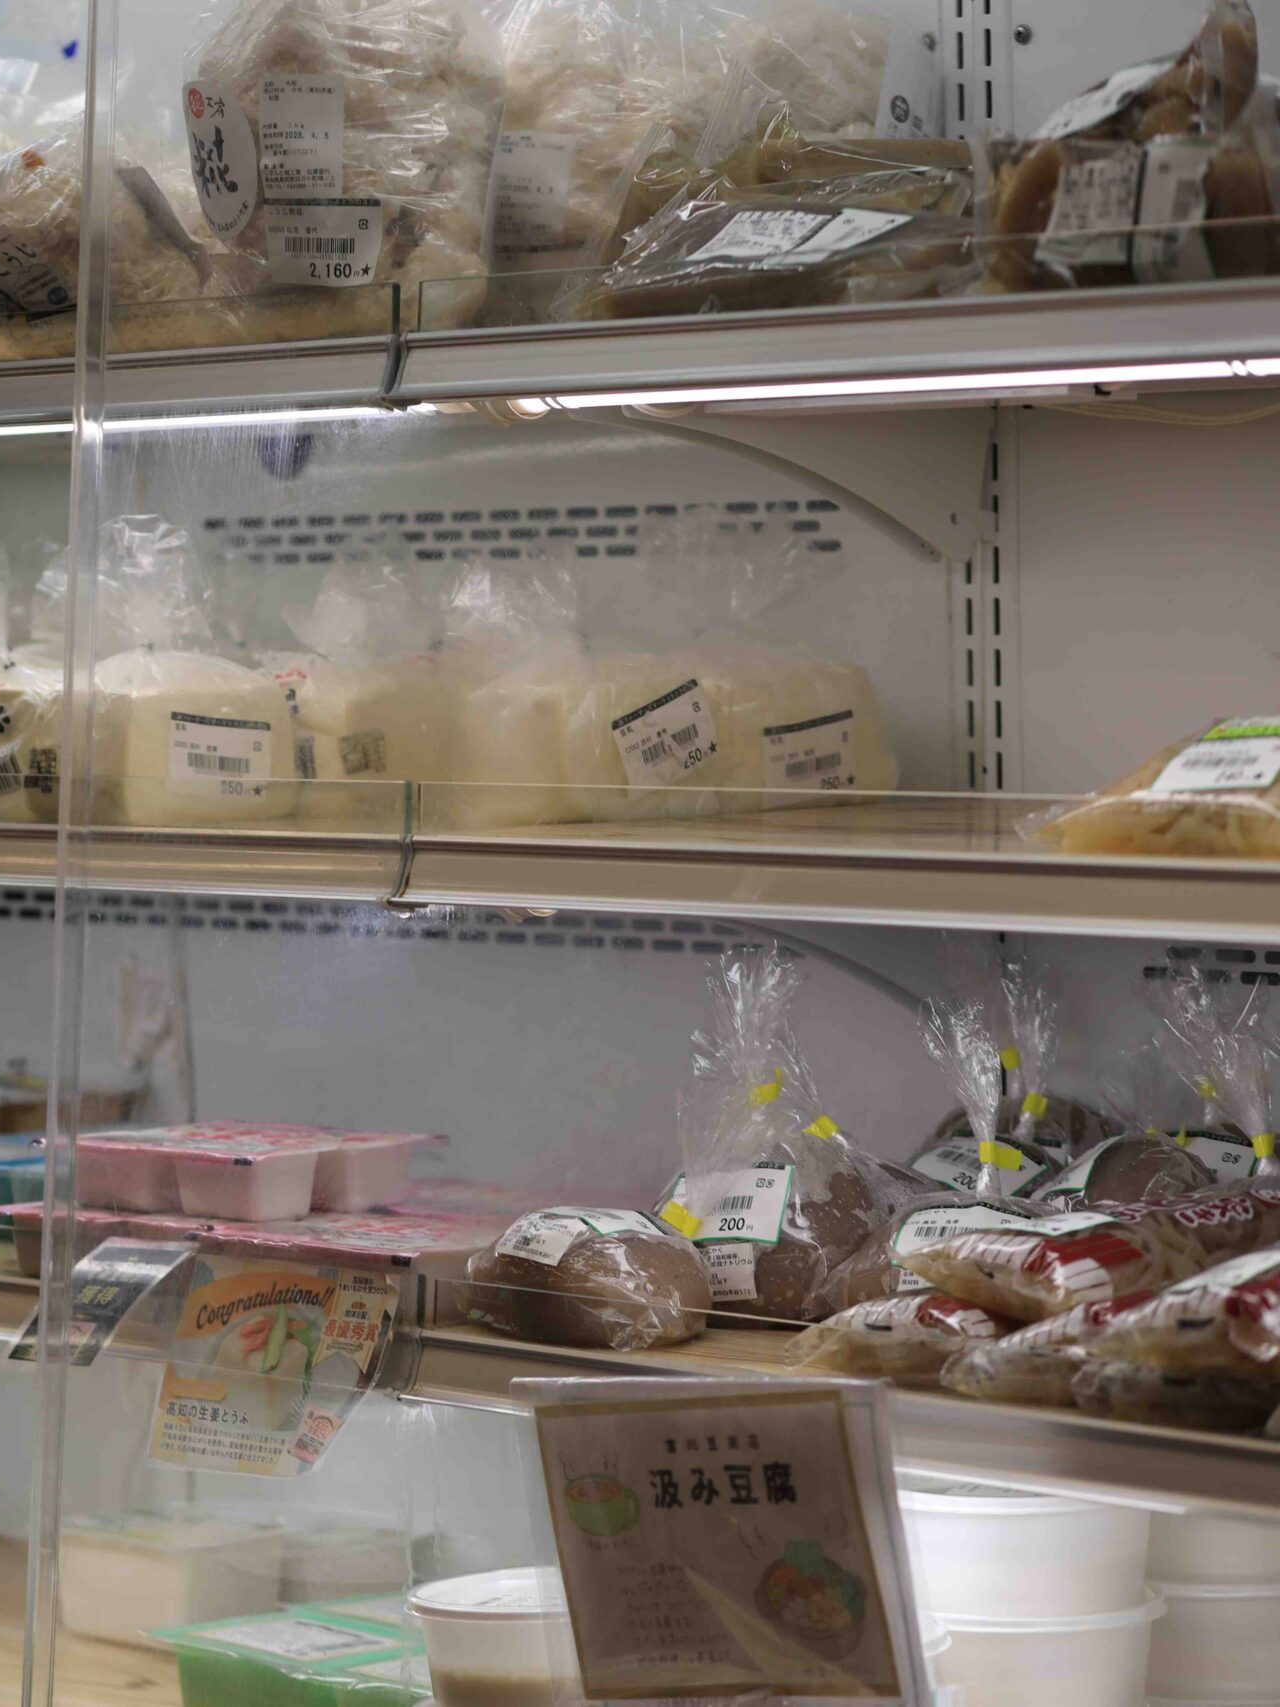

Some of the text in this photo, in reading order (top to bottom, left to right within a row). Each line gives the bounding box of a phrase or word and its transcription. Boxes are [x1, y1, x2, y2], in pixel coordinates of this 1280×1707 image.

[196, 1281, 336, 1330] Congratulations!!
[324, 1319, 379, 1343] 最優秀賞
[166, 1401, 250, 1425] 高知の生姜とうふ
[649, 1461, 798, 1510] 汲み豆腐
